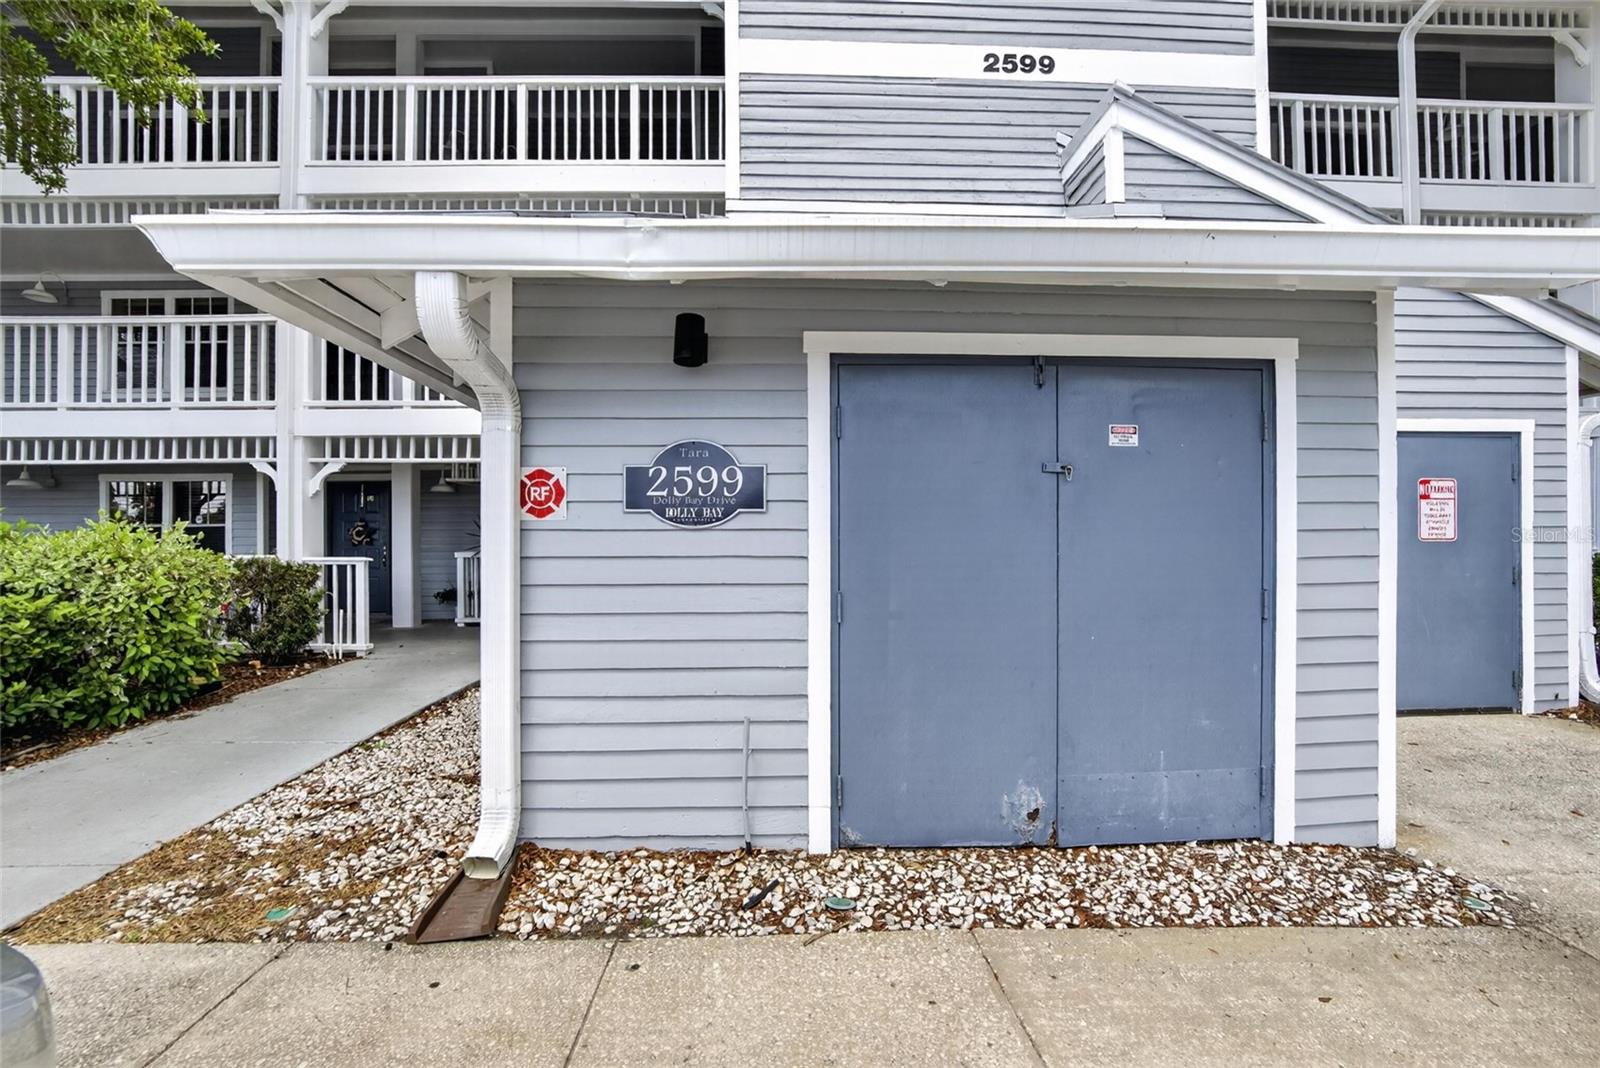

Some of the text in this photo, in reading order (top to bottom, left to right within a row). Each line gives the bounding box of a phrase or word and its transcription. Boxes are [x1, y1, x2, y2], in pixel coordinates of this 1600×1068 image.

[983, 53, 1055, 75] 2599
[679, 448, 709, 457] Tara
[646, 465, 743, 497] 2599
[530, 486, 550, 502] RF
[653, 496, 737, 506] Dolly Bay Drive
[703, 507, 725, 518] BAY
